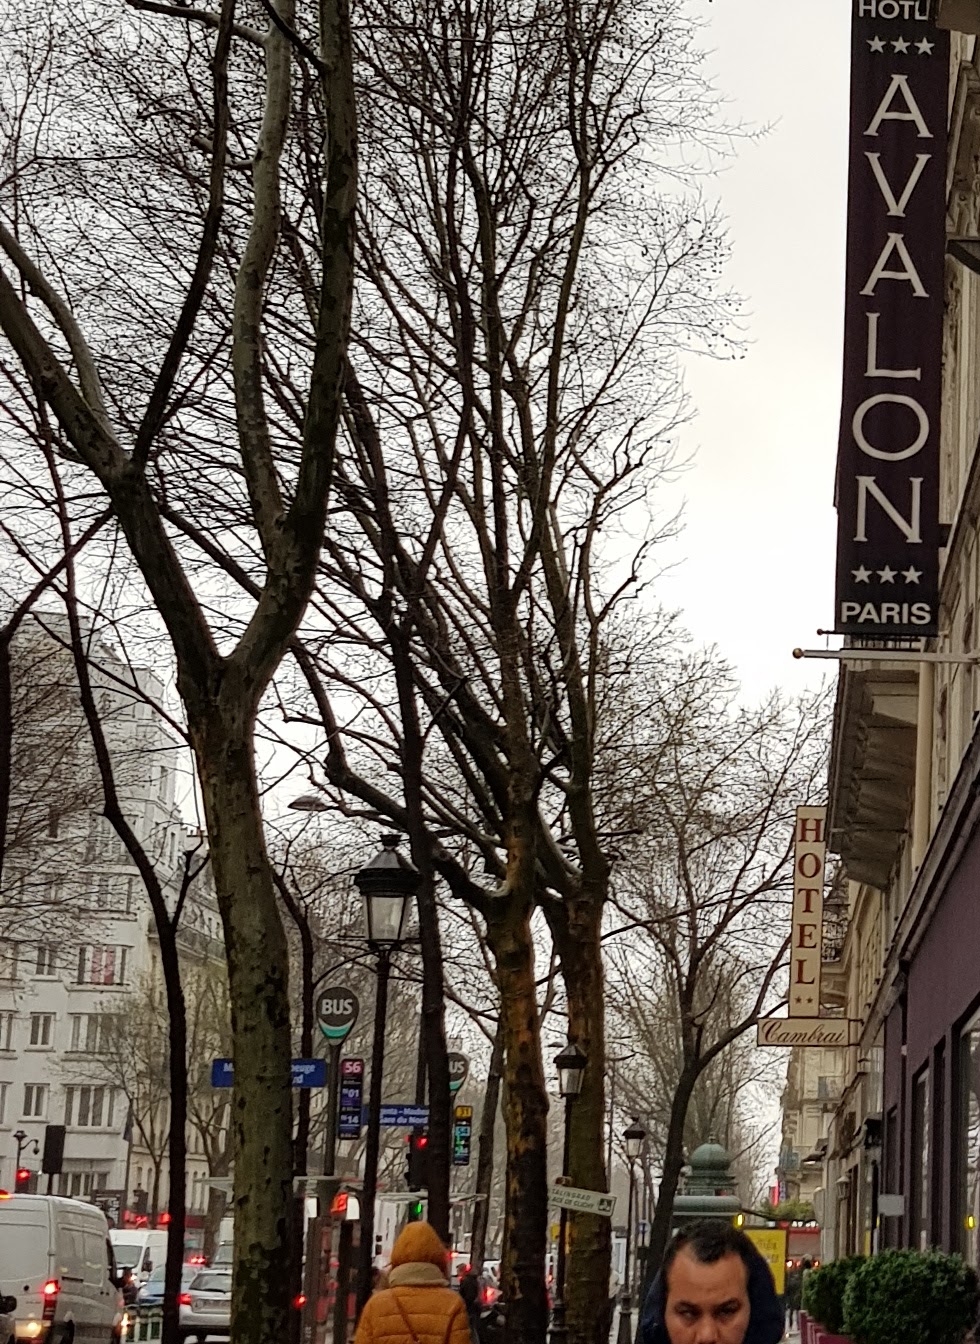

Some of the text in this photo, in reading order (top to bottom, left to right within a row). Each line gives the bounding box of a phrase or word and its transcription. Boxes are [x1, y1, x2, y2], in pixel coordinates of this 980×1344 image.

[852, 74, 934, 544] AVALON
[841, 601, 932, 625] PARIS
[795, 818, 823, 986] HOTEL
[321, 998, 353, 1015] BUS
[761, 1020, 845, 1044] Cambrai
[345, 1061, 362, 1073] 56
[449, 1061, 465, 1074] US
